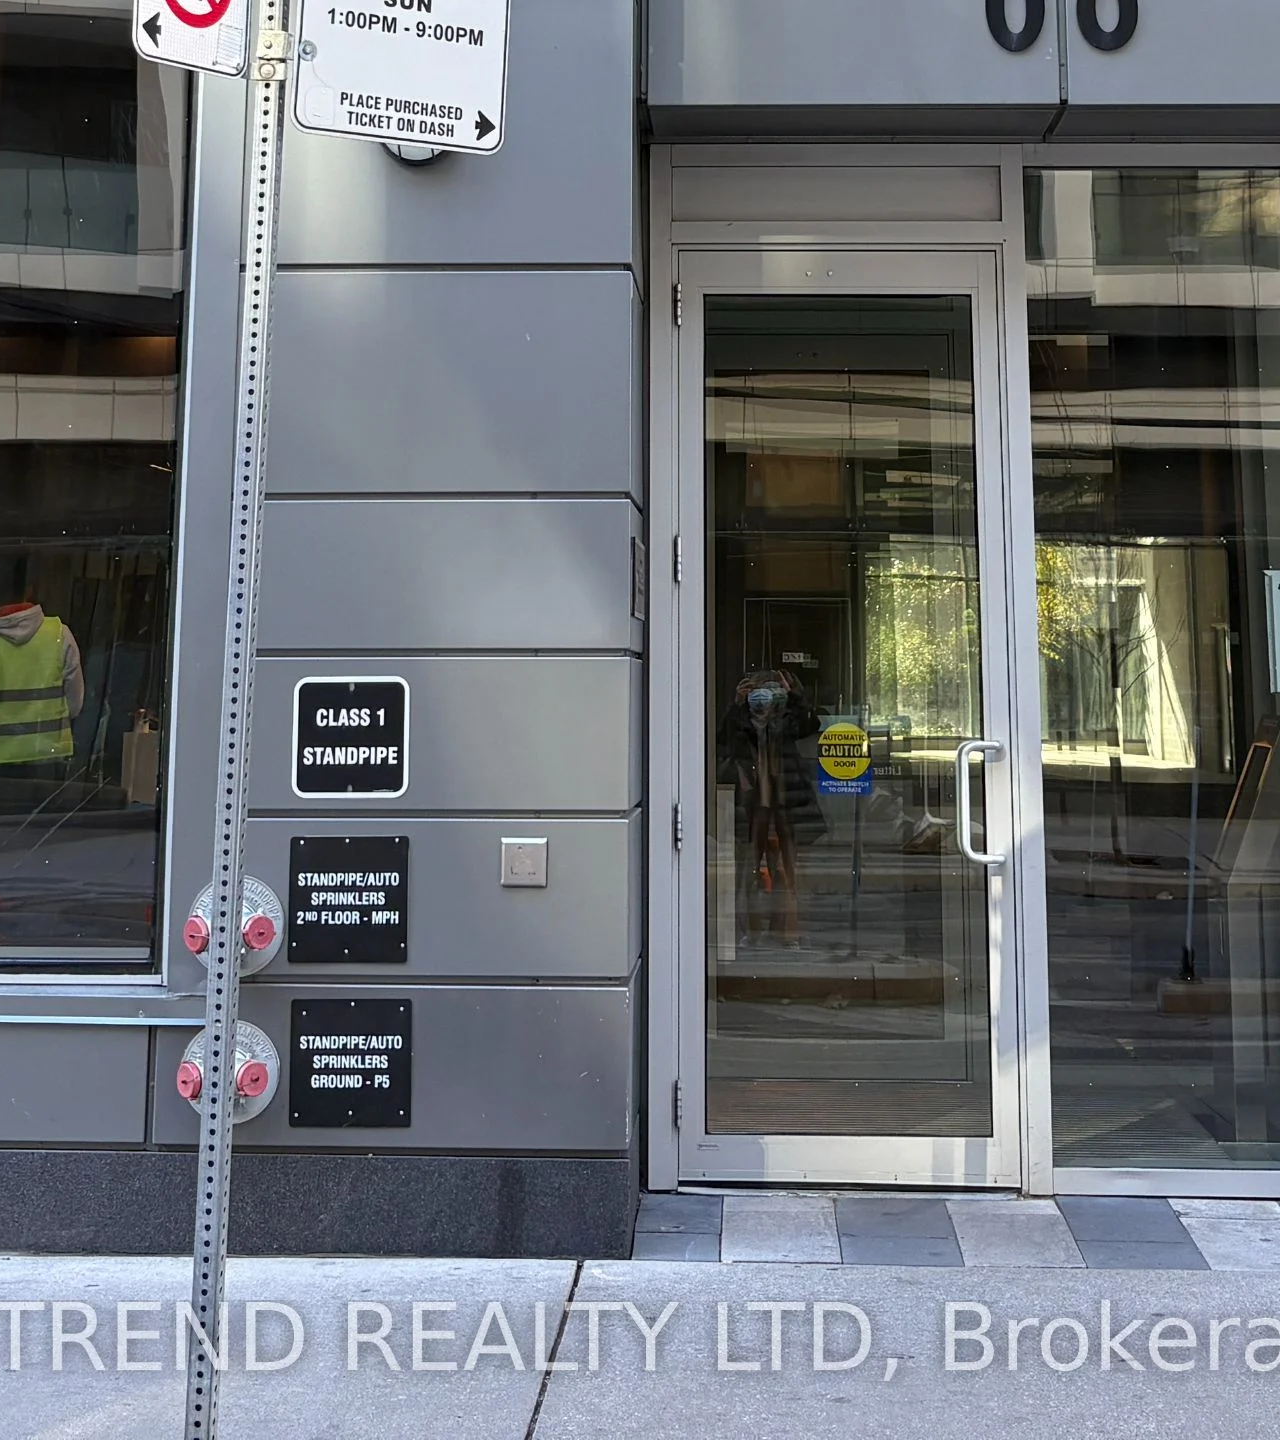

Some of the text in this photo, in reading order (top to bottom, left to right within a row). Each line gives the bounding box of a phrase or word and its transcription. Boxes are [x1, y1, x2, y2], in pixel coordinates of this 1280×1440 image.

[327, 8, 397, 35] 1:00PM
[416, 20, 484, 47] 9:00PM
[340, 91, 463, 121] PLACE PURCHASED
[347, 110, 455, 138] TICKET ON DASH
[315, 708, 386, 727] CLASS 1
[822, 733, 867, 742] AUTOMATIC
[302, 746, 398, 765] STANDPIPE
[821, 745, 869, 756] CAUTION
[833, 760, 856, 768] DOOR
[297, 871, 400, 888] STANDPIPE/AUTO
[311, 891, 386, 906] SPRINKLERS
[296, 910, 318, 926] 2ND
[320, 910, 360, 926] FLOOR
[371, 910, 399, 925] MPH
[299, 1035, 403, 1051] STANDPIPE/AUTO
[313, 1054, 388, 1069] SPRINKLERS
[311, 1074, 363, 1090] GROUND
[374, 1073, 390, 1089] P5
